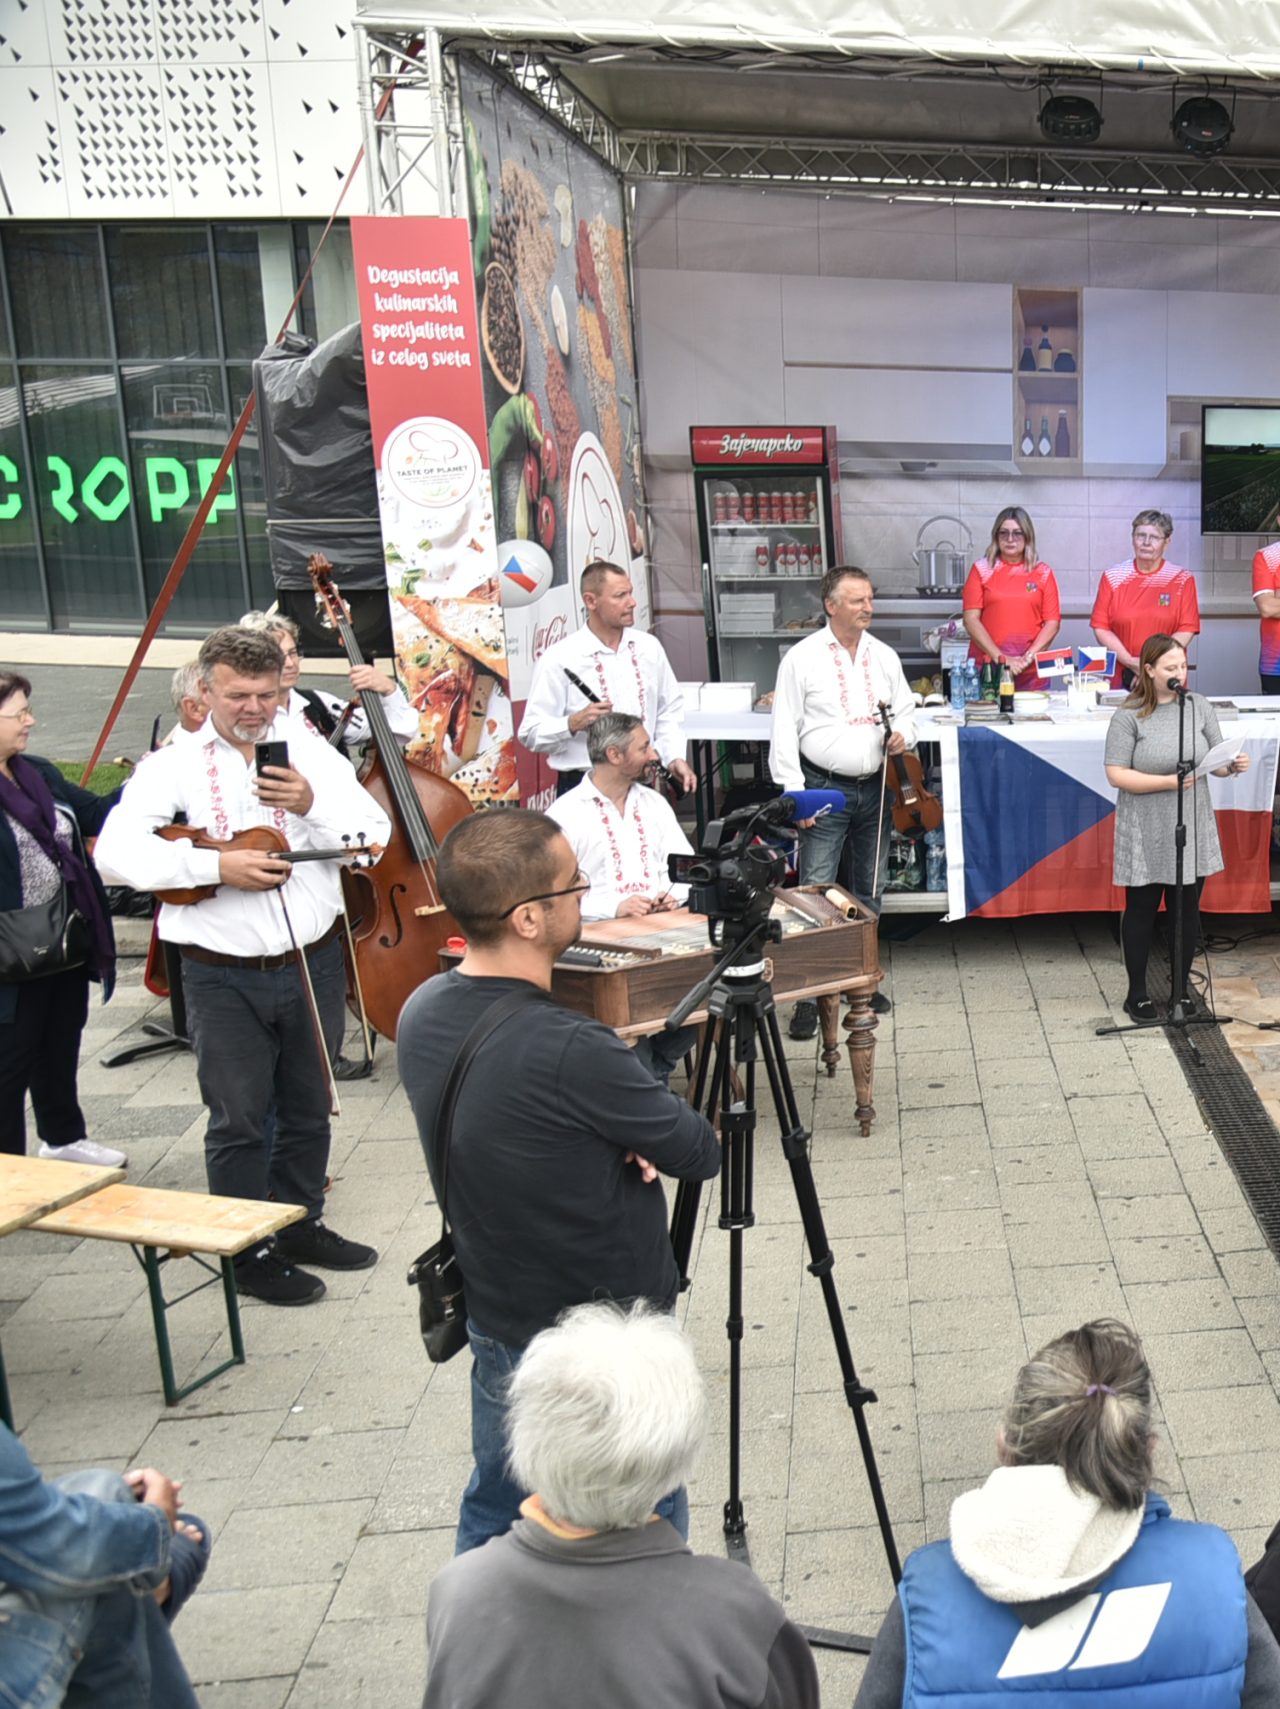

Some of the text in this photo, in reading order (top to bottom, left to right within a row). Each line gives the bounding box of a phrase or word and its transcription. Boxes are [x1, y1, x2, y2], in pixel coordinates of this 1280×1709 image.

[367, 265, 460, 290] Degustacija
[374, 292, 458, 314] kulinarskih
[372, 320, 465, 344] specijaliteta
[371, 348, 471, 371] iz celog sveta
[719, 433, 803, 458] Зајечарско
[397, 469, 421, 477] TASTE
[437, 465, 468, 473] PLANET
